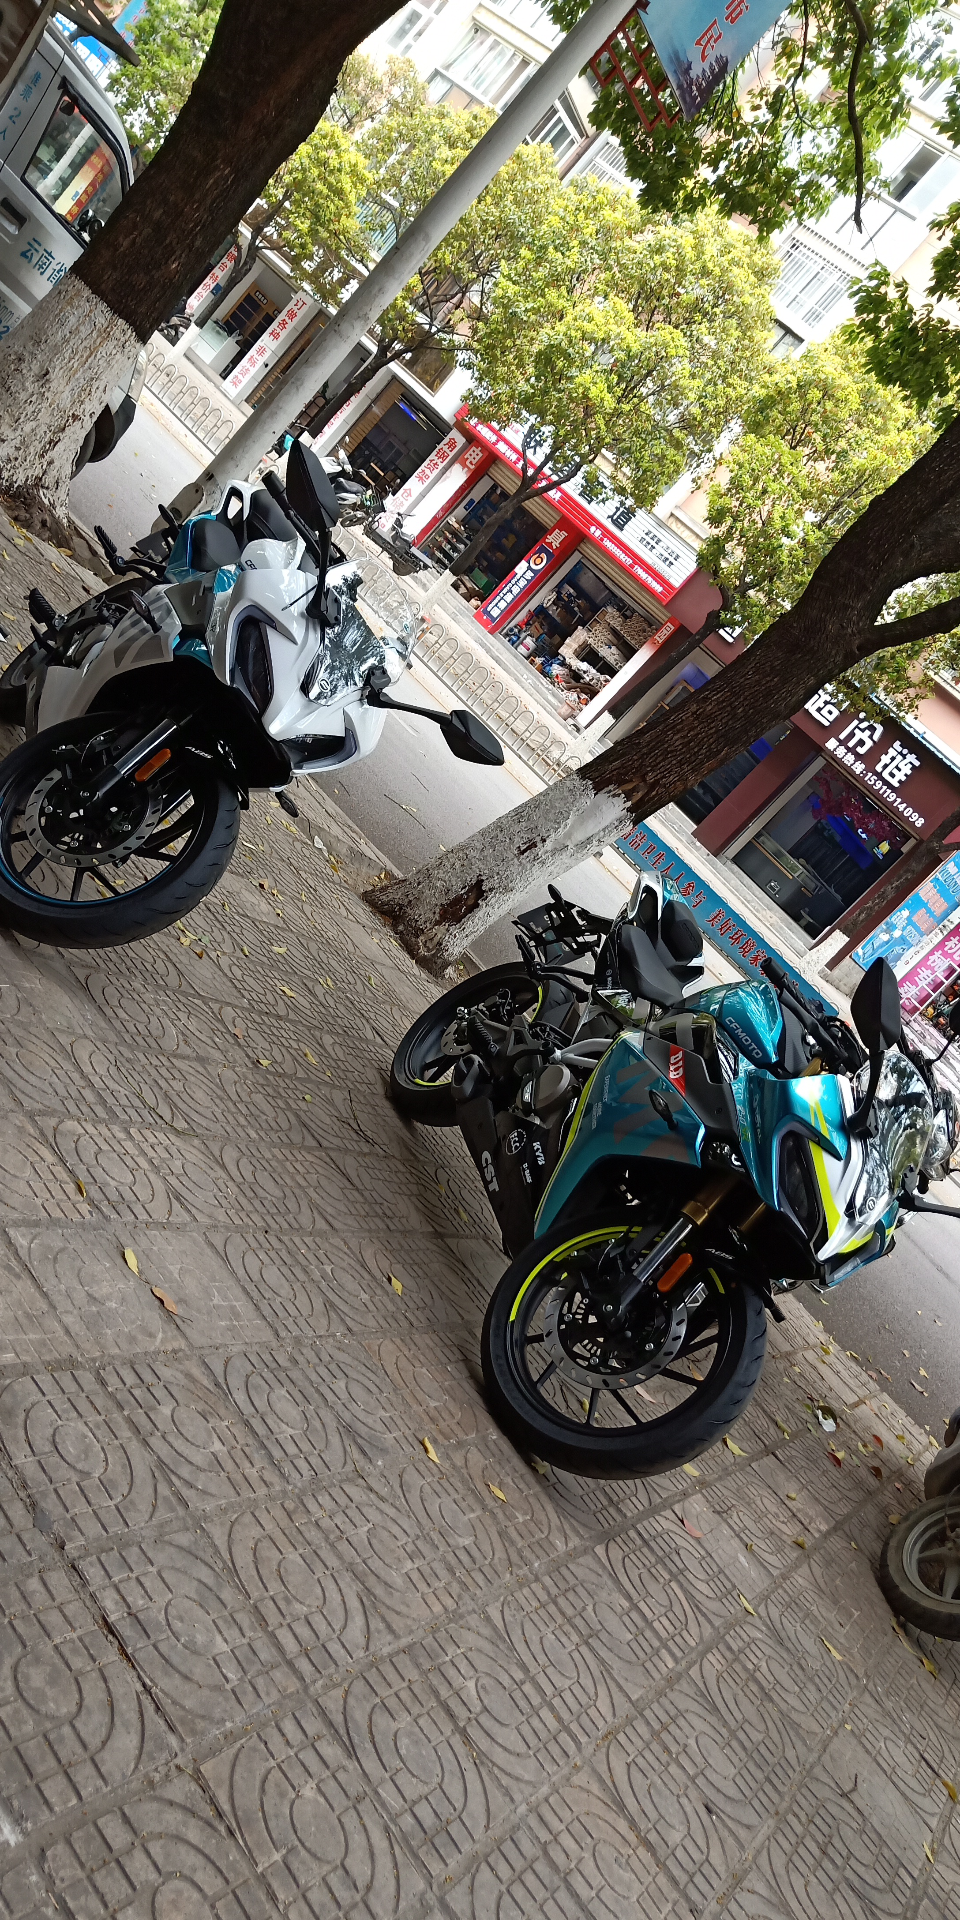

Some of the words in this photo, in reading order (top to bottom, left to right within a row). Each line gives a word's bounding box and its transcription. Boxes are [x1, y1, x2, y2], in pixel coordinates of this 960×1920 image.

[20, 237, 69, 288] 云南省
[268, 297, 307, 342] 订做各种
[229, 344, 267, 389] 非标货架
[414, 436, 458, 486] 角钢货架
[724, 1016, 763, 1059] CFMOTO
[669, 1050, 683, 1079] DID
[481, 1150, 500, 1192] CST
